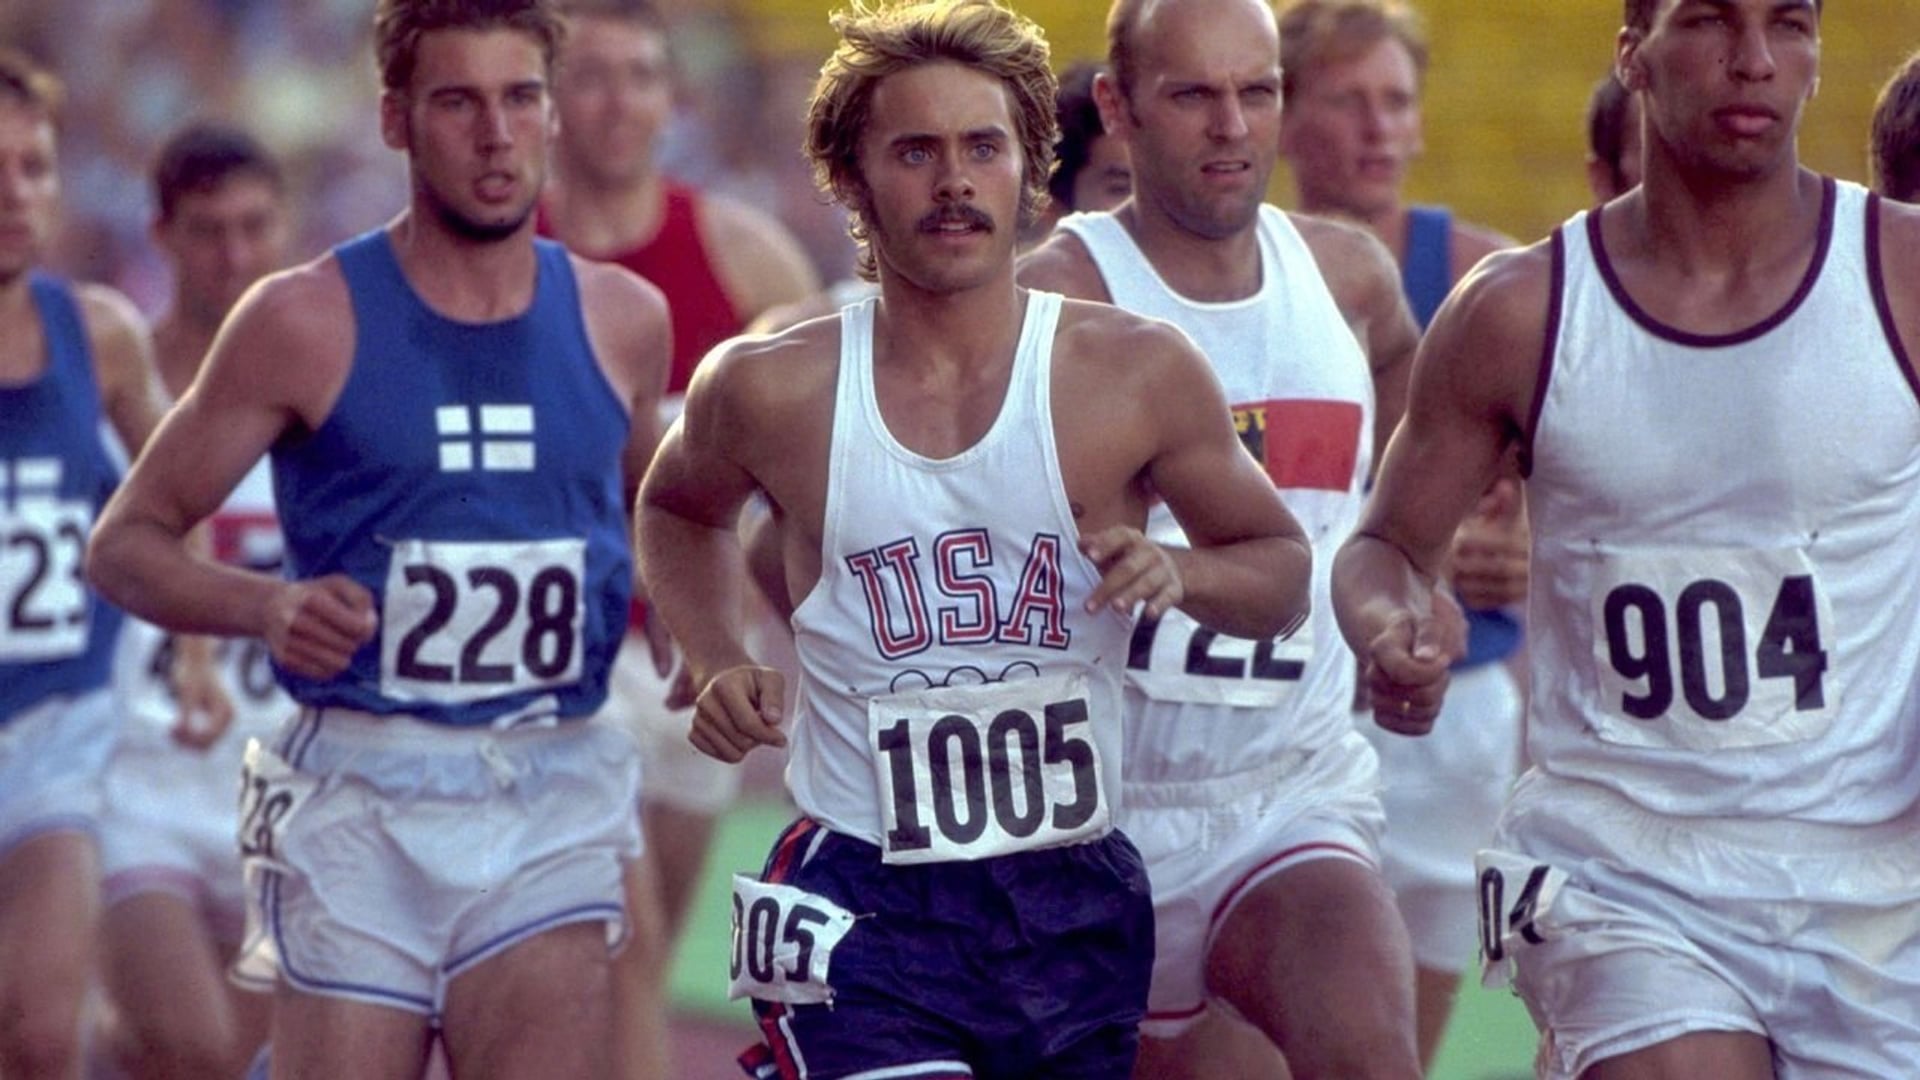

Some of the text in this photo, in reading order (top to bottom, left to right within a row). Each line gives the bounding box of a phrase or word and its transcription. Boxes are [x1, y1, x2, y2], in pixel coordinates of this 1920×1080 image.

[395, 564, 579, 685] 228
[845, 528, 1071, 661] USA
[1603, 574, 1828, 721] 904
[878, 699, 1097, 852] 1005
